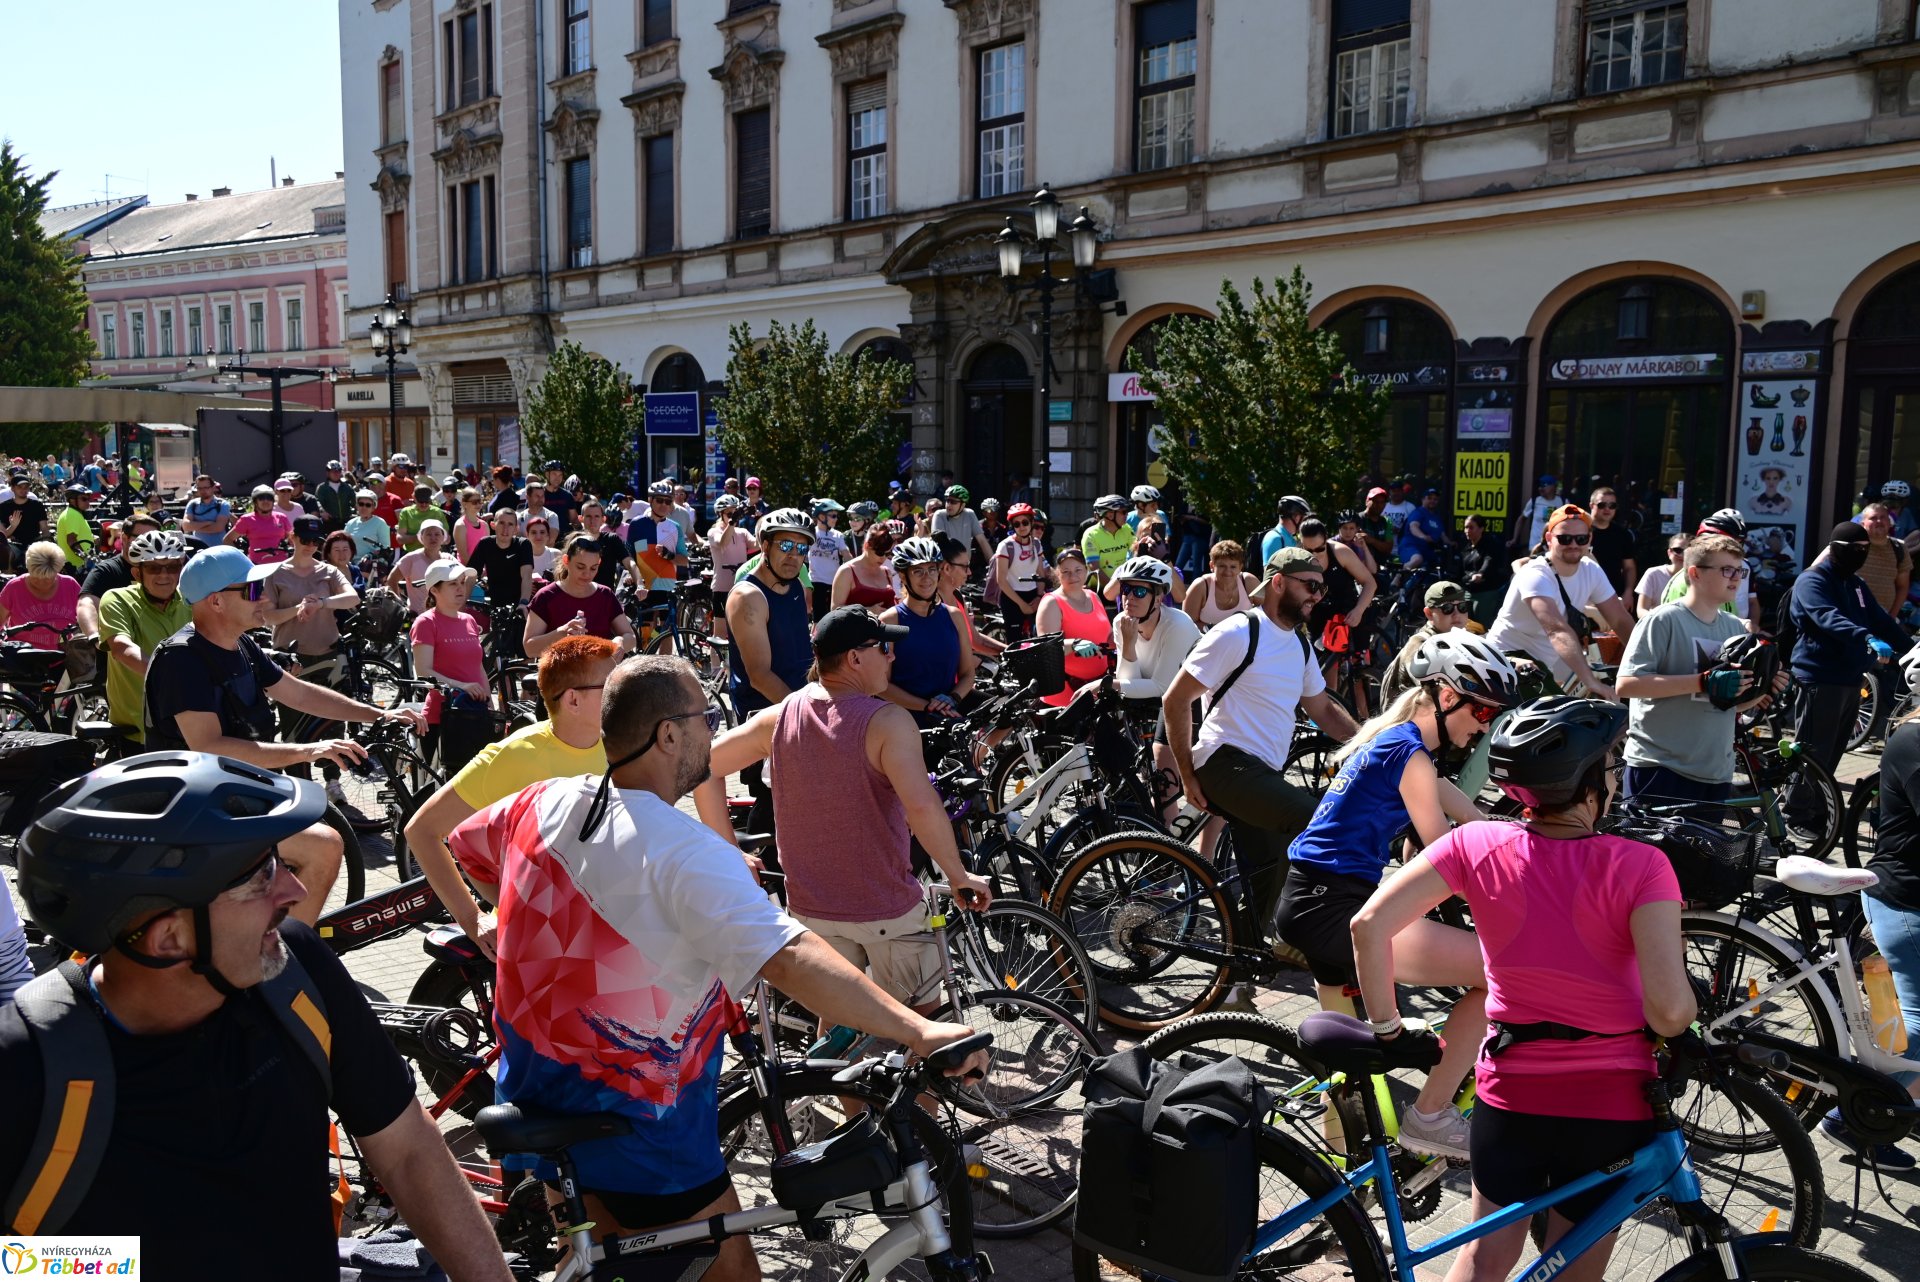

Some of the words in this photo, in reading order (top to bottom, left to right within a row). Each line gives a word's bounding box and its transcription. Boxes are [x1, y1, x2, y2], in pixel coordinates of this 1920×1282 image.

[347, 391, 375, 401] MARELLA
[653, 405, 689, 415] GEDEON
[1459, 454, 1505, 479] KIADÓ
[1456, 486, 1505, 511] ELADÓ
